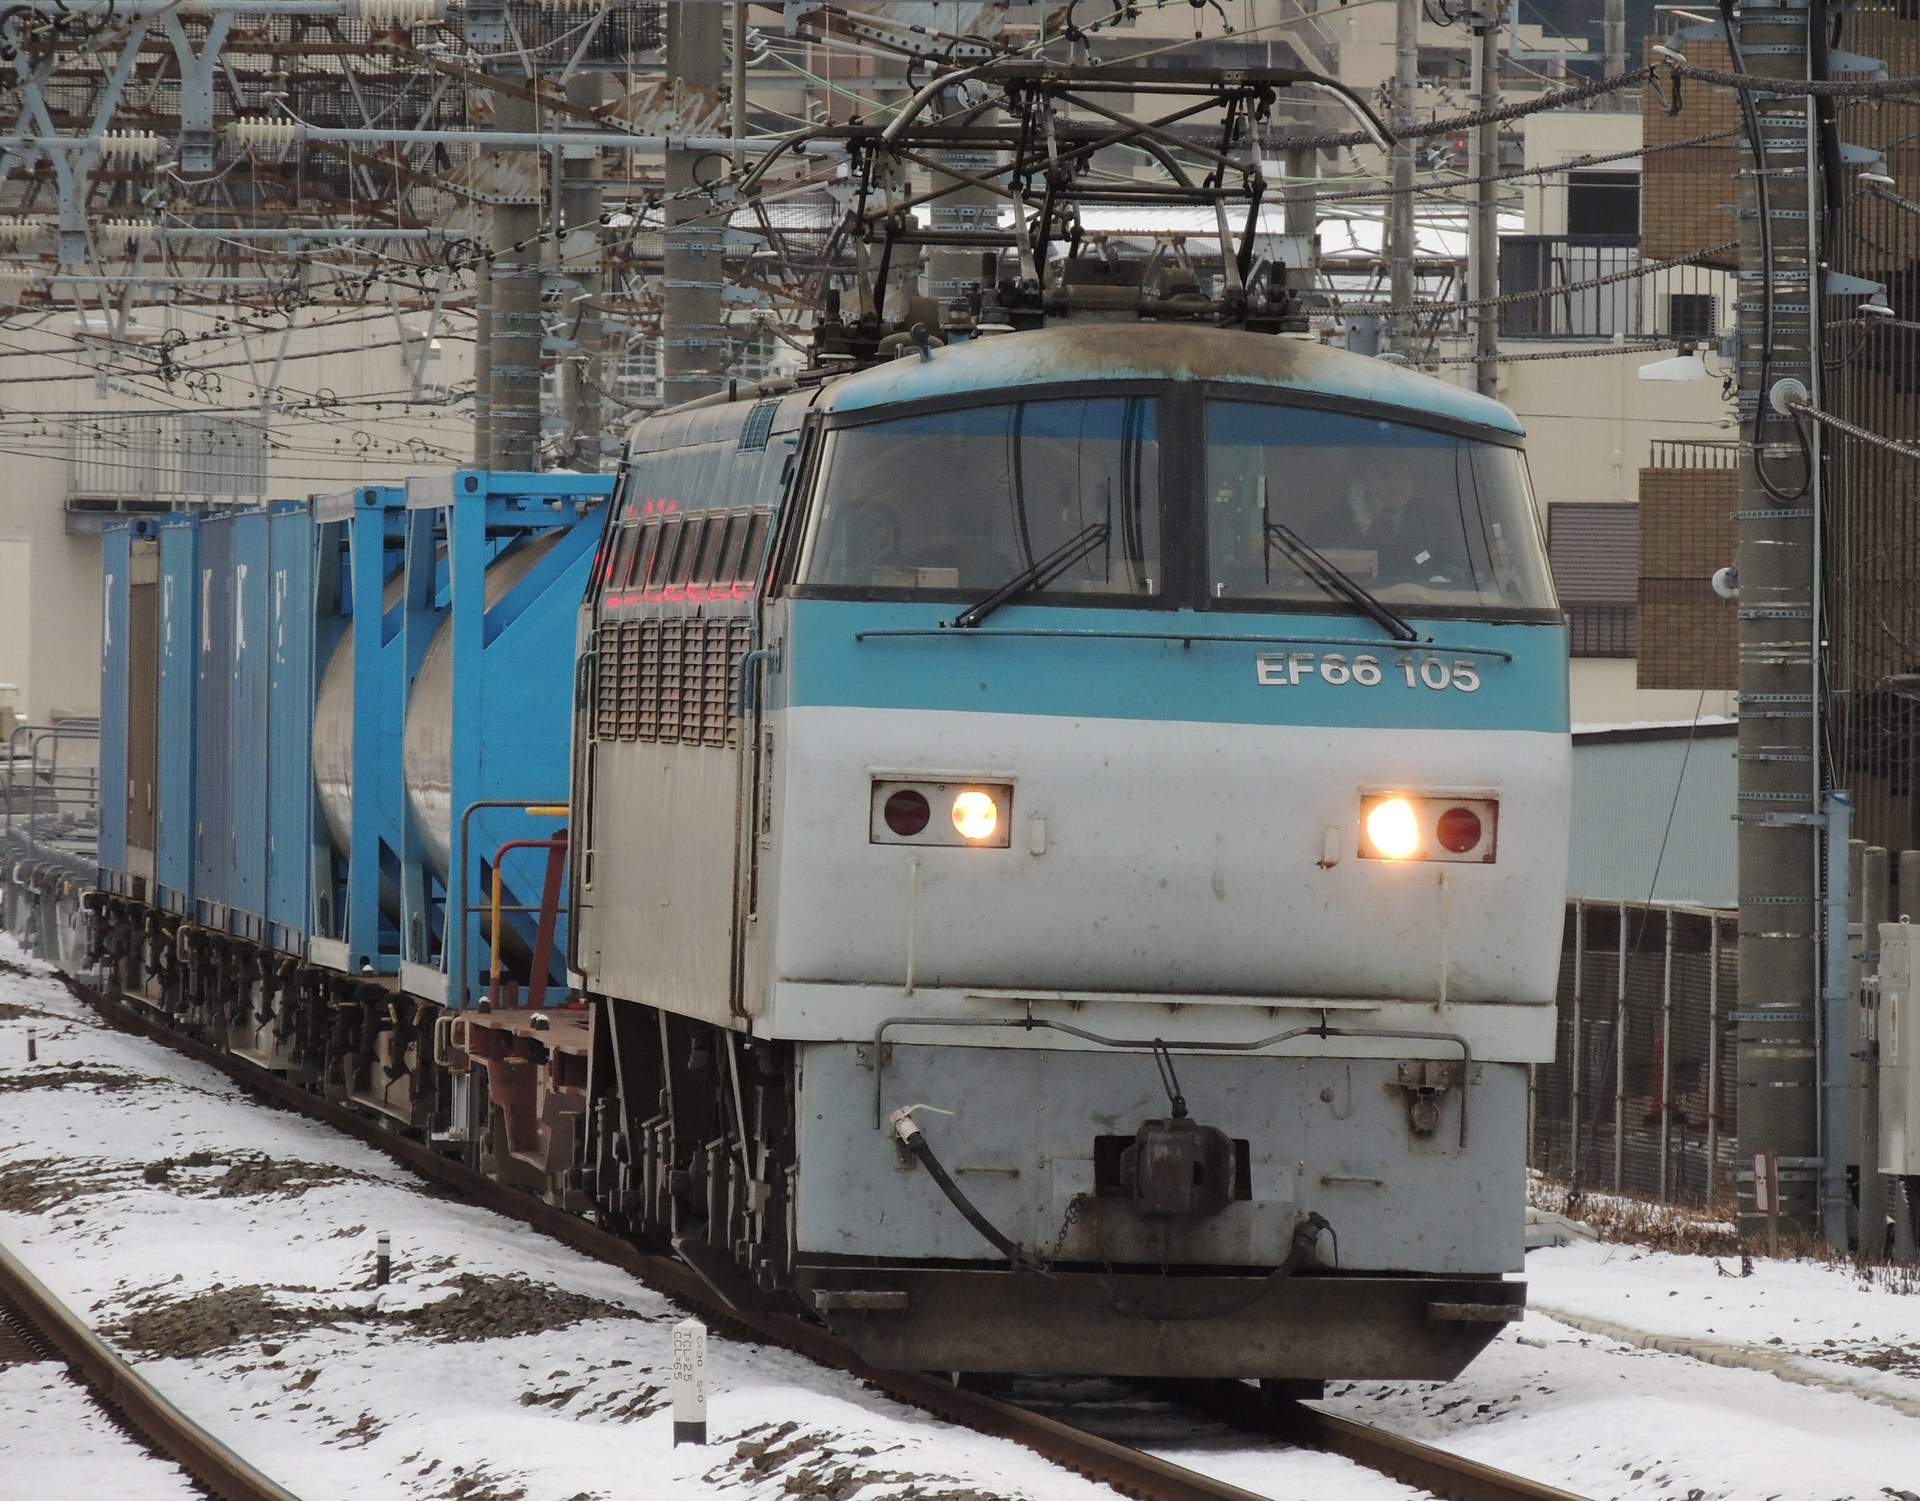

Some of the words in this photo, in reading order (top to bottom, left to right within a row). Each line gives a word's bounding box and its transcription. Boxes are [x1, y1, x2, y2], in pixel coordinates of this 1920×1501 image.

[1255, 653, 1383, 687] EF66
[1396, 656, 1481, 693] 105
[673, 1331, 682, 1380] CCL=65
[682, 1331, 692, 1382] TCL=25
